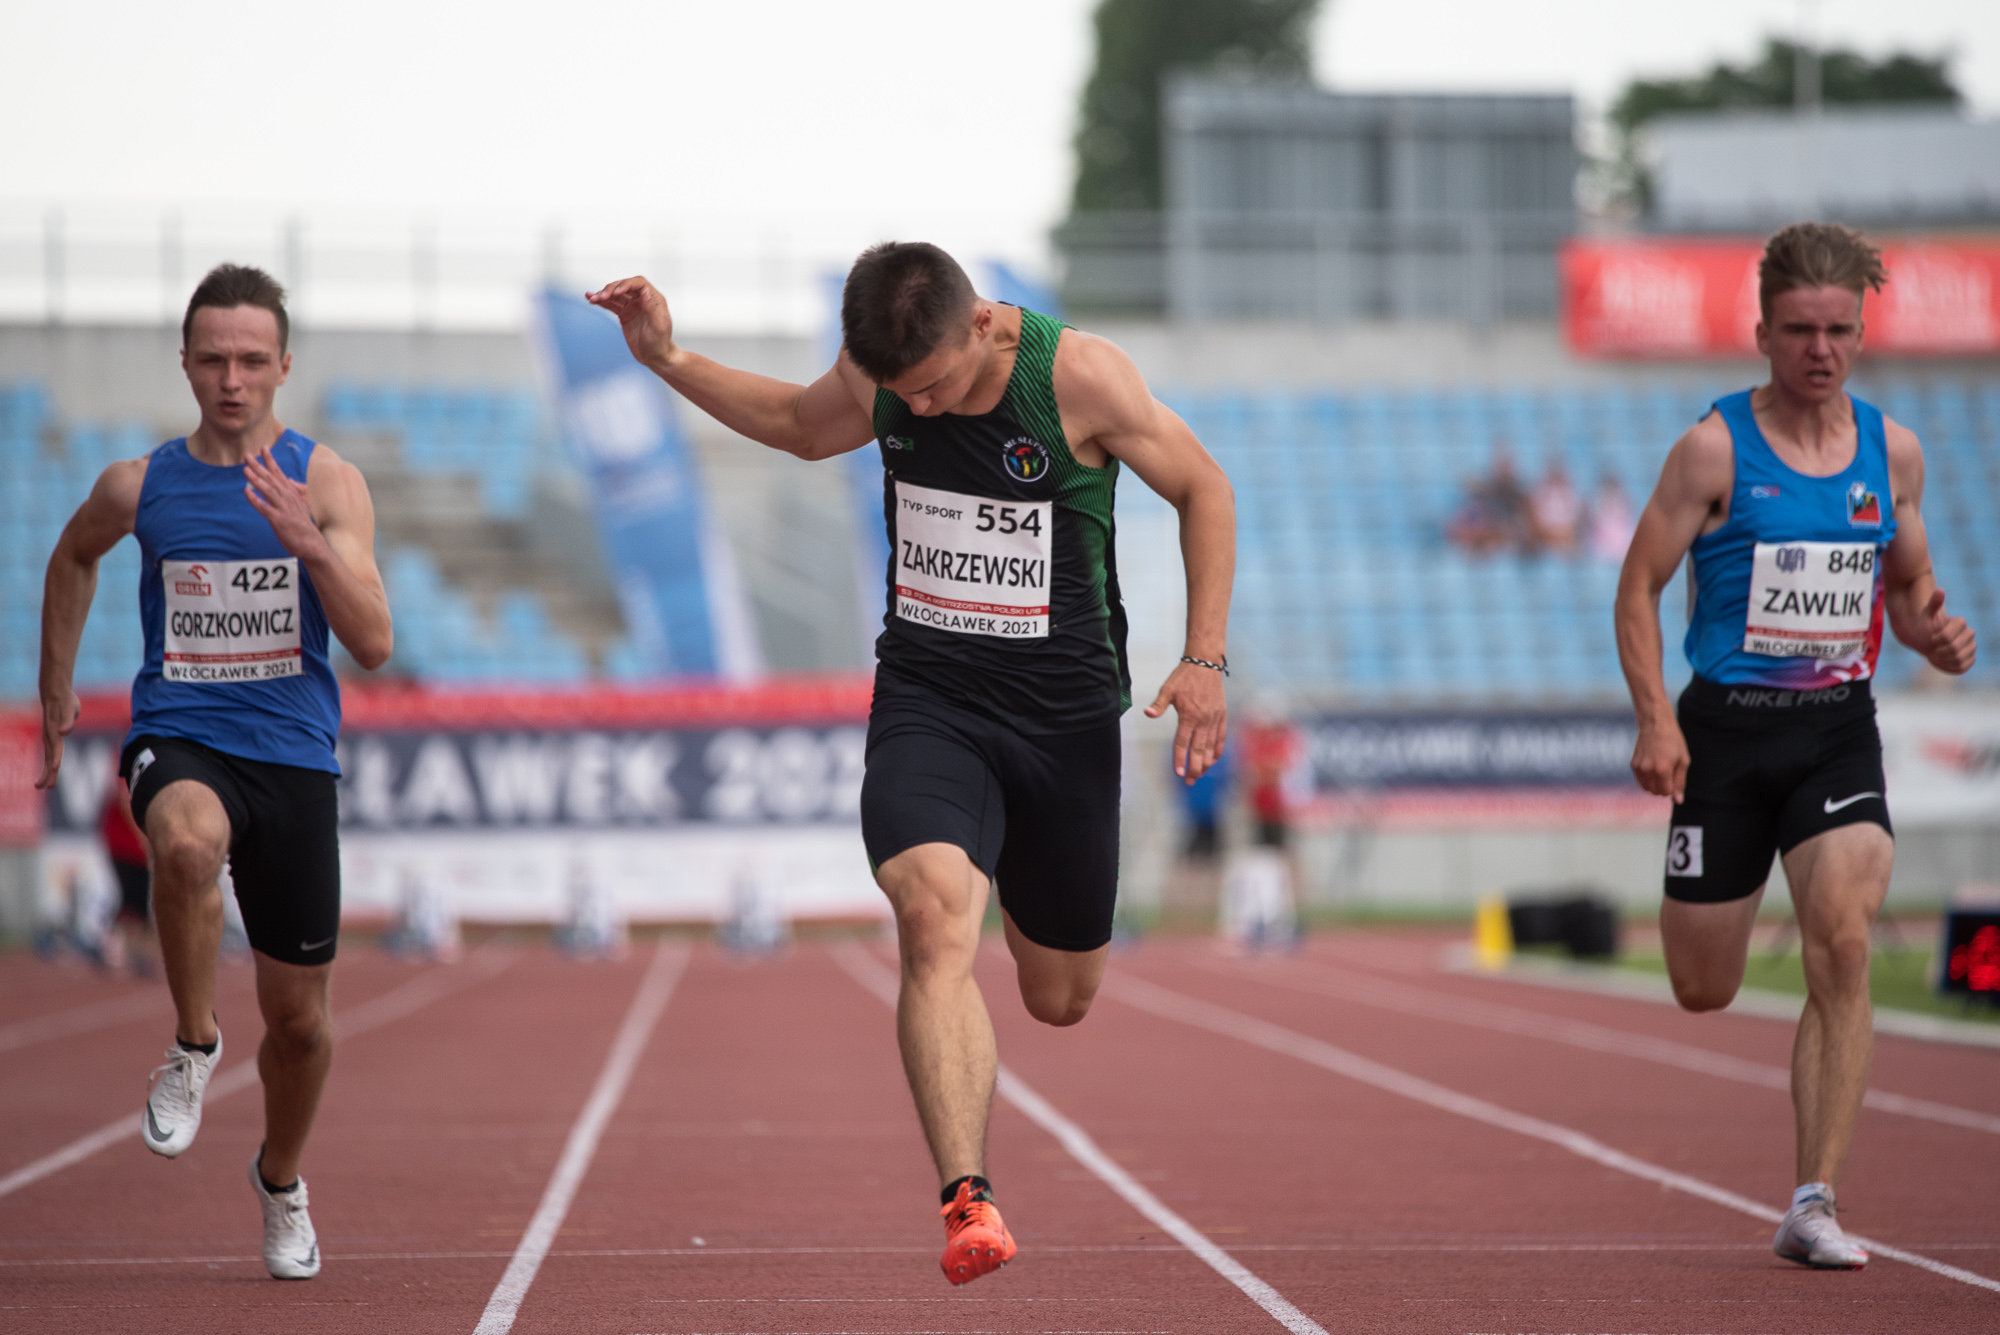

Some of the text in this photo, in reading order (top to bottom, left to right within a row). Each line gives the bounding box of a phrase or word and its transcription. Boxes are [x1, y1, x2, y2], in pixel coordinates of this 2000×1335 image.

[902, 499, 963, 520] TVP SPORT
[975, 503, 1042, 538] 554
[902, 539, 1045, 588] ZAKRZEWSKI
[1828, 549, 1873, 574] 848
[231, 565, 290, 592] 422
[993, 606, 1025, 615] POLSKI
[1763, 588, 1864, 617] ZAWLIK
[171, 608, 294, 637] GORZKOWICZ
[901, 602, 1038, 635] WŁOCŁAWEK 2021
[169, 661, 294, 681] WŁOCŁAWEK 2021
[1726, 686, 1850, 707] NIKE PRO
[1673, 832, 1691, 871] 3
